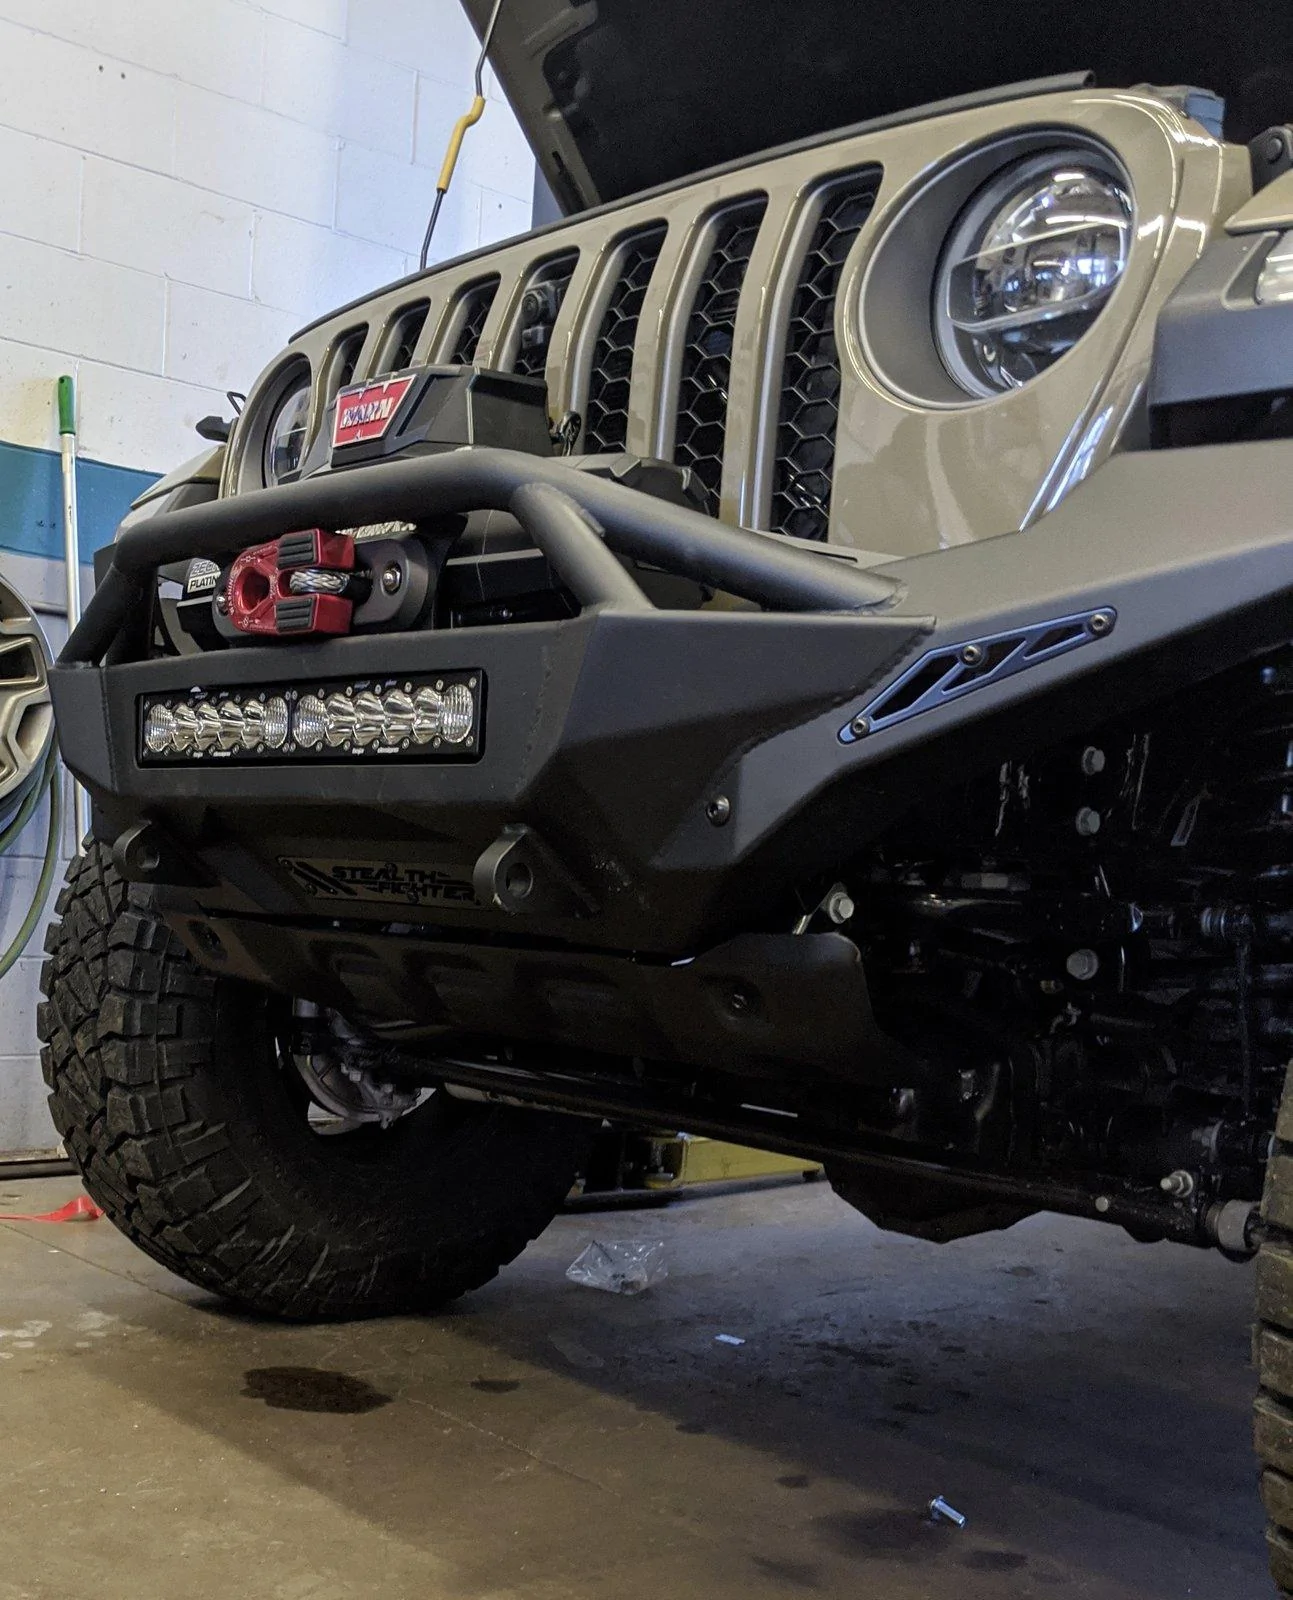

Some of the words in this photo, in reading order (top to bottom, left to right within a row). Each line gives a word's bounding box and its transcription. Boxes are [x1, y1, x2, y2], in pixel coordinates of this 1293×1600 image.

[340, 398, 393, 428] WARN
[333, 866, 438, 882] STEALTH
[377, 882, 475, 900] FIGHTER
